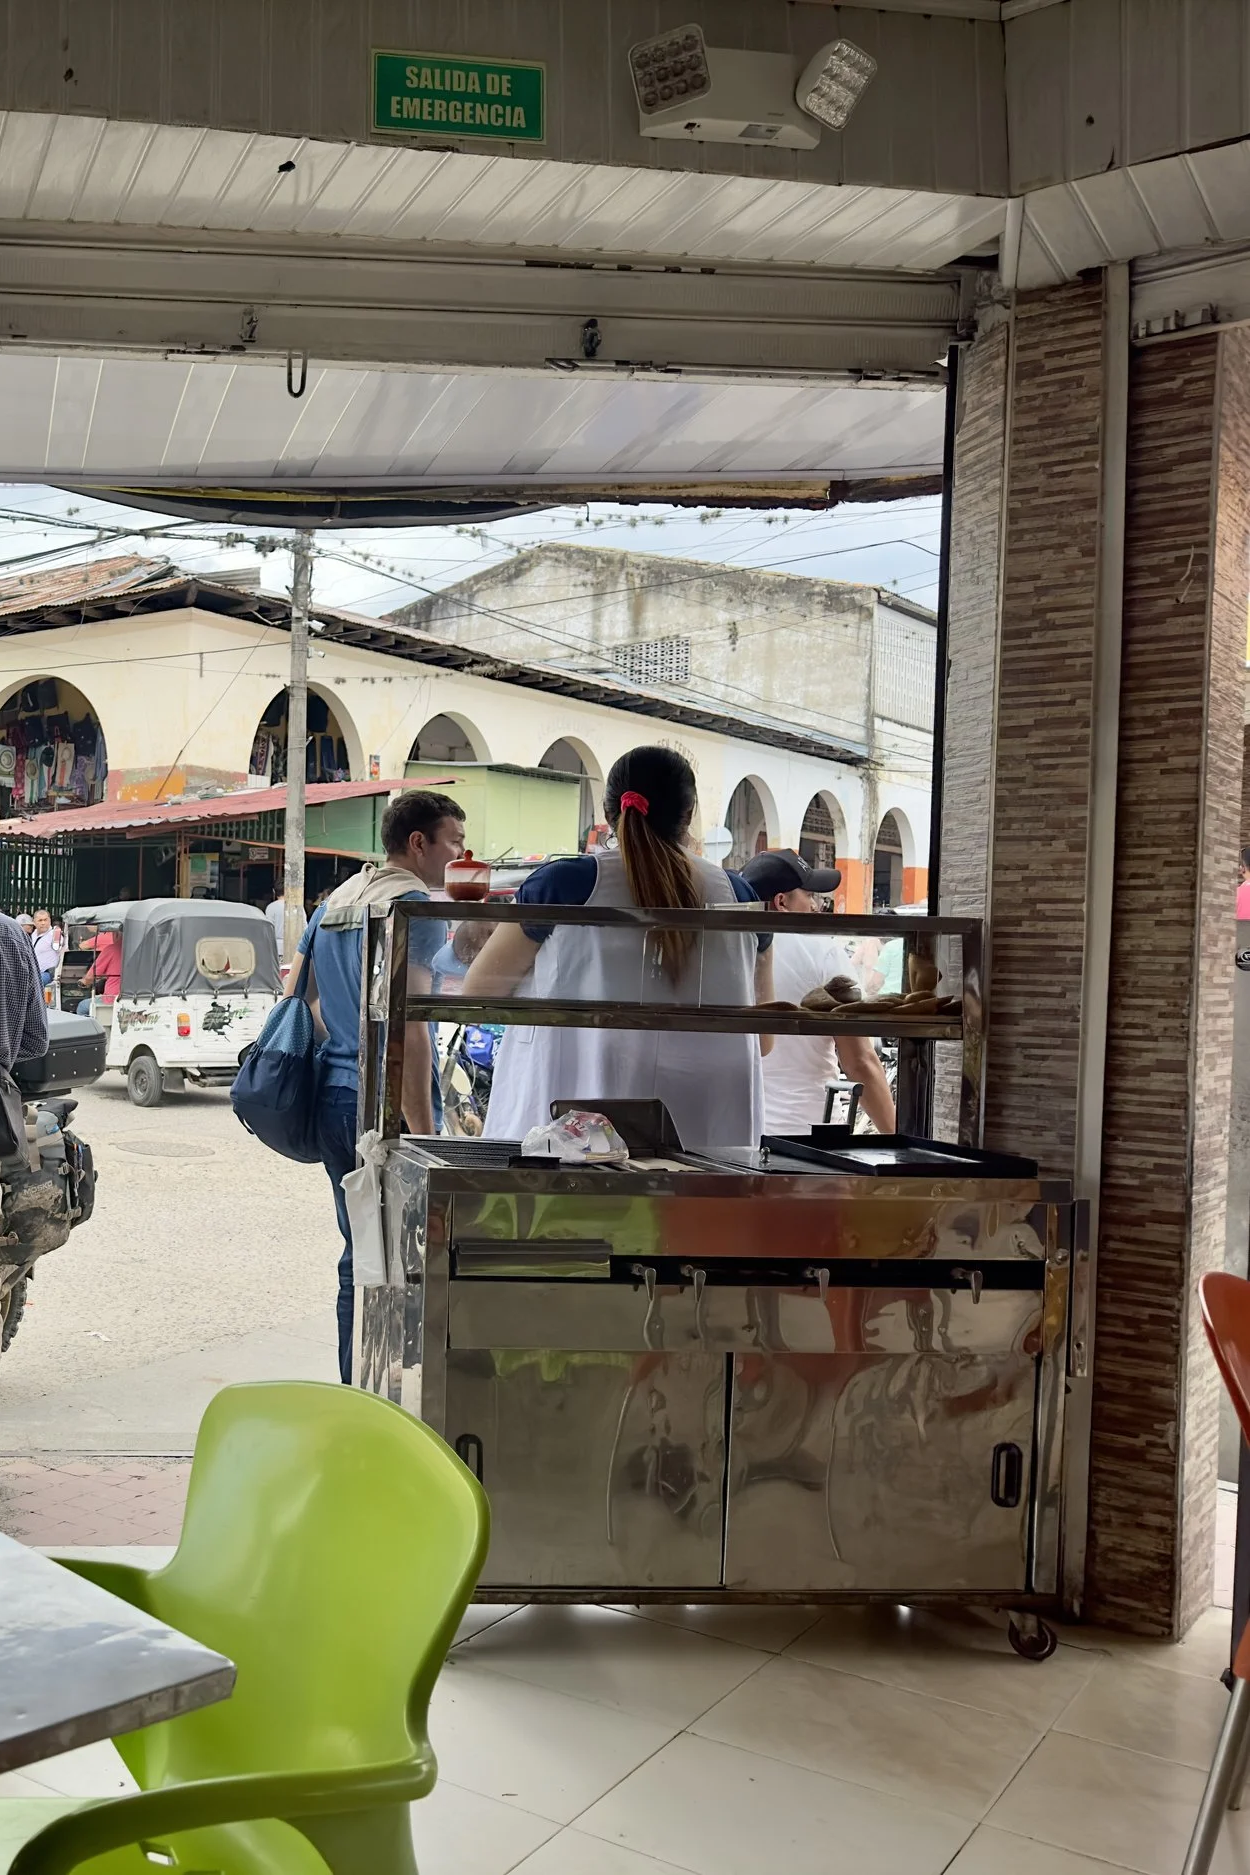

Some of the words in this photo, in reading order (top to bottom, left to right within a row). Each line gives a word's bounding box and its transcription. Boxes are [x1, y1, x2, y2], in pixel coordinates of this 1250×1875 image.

[405, 65, 481, 94] SALIDA
[486, 73, 512, 96] DE
[390, 95, 527, 129] EMERGENCIA
